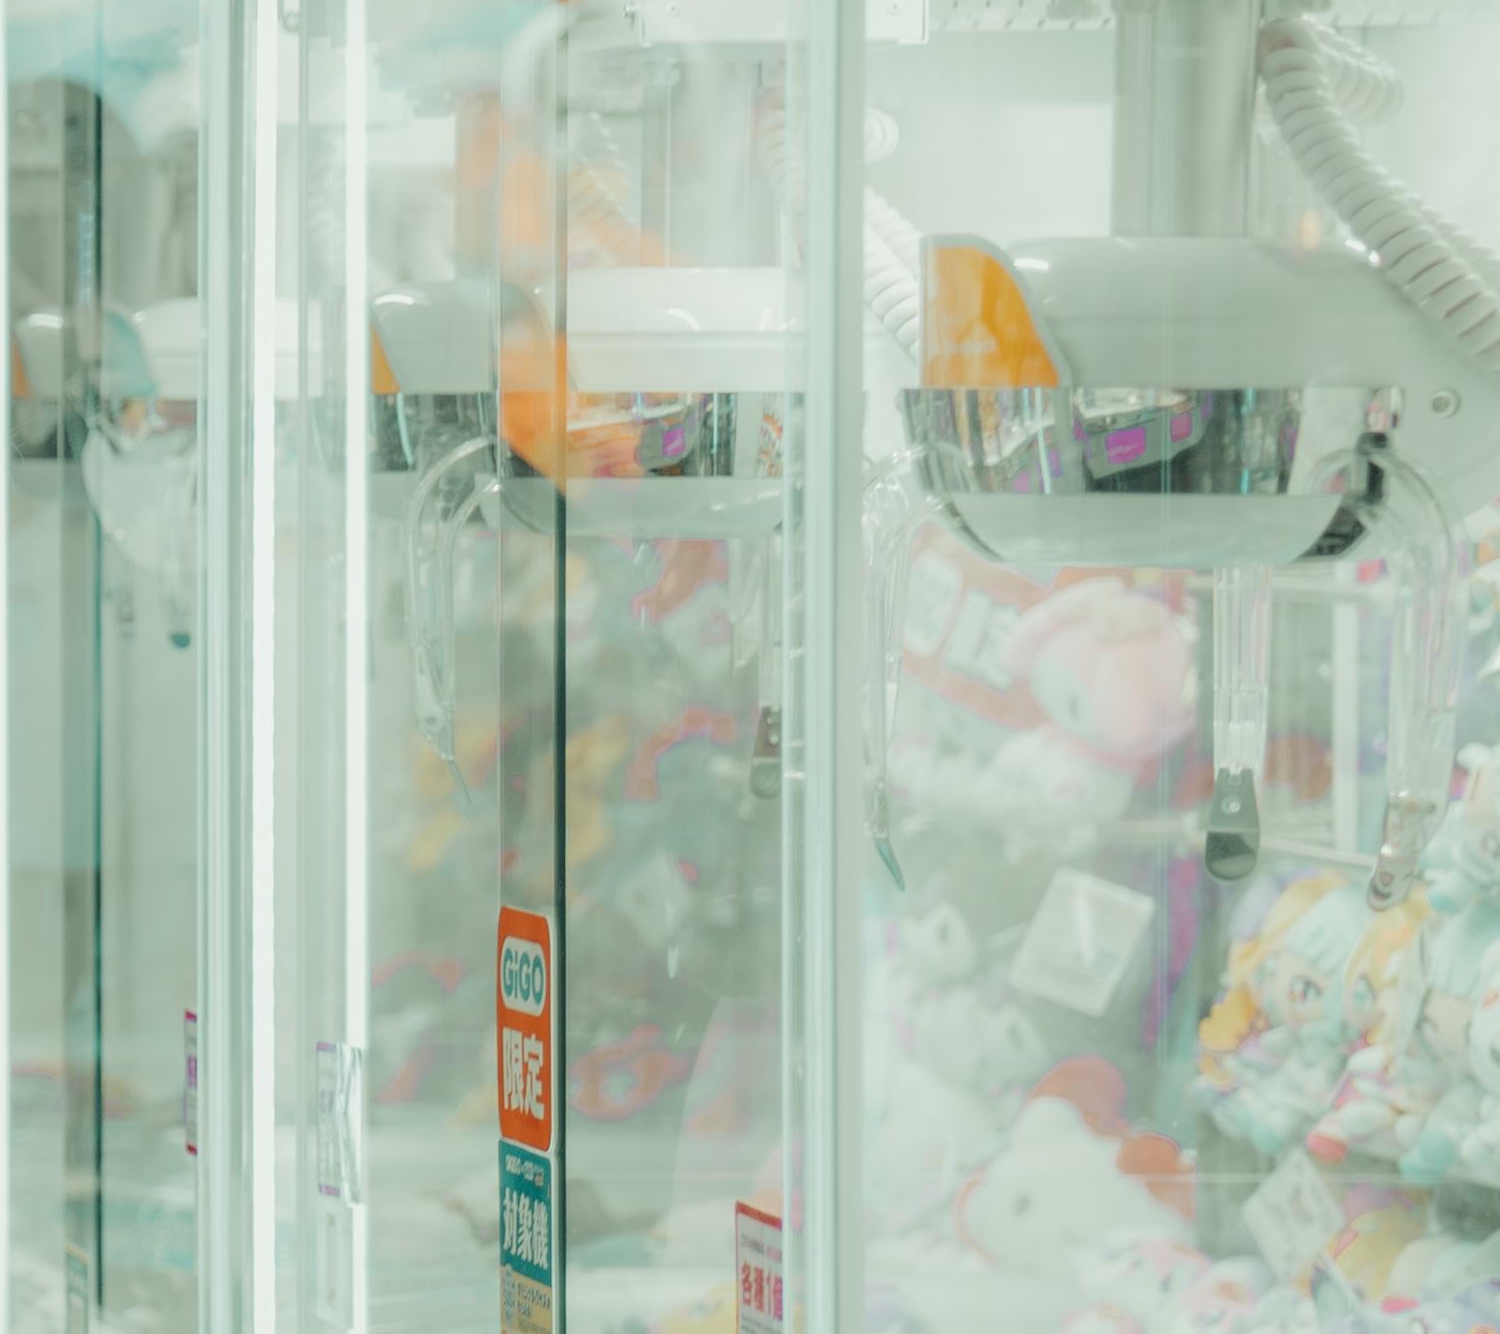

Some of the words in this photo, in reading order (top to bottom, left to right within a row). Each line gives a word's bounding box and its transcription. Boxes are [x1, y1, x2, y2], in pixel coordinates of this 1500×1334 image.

[502, 946, 545, 1007] GiGO
[502, 1026, 546, 1121] 限定
[502, 1186, 549, 1270] 対象機
